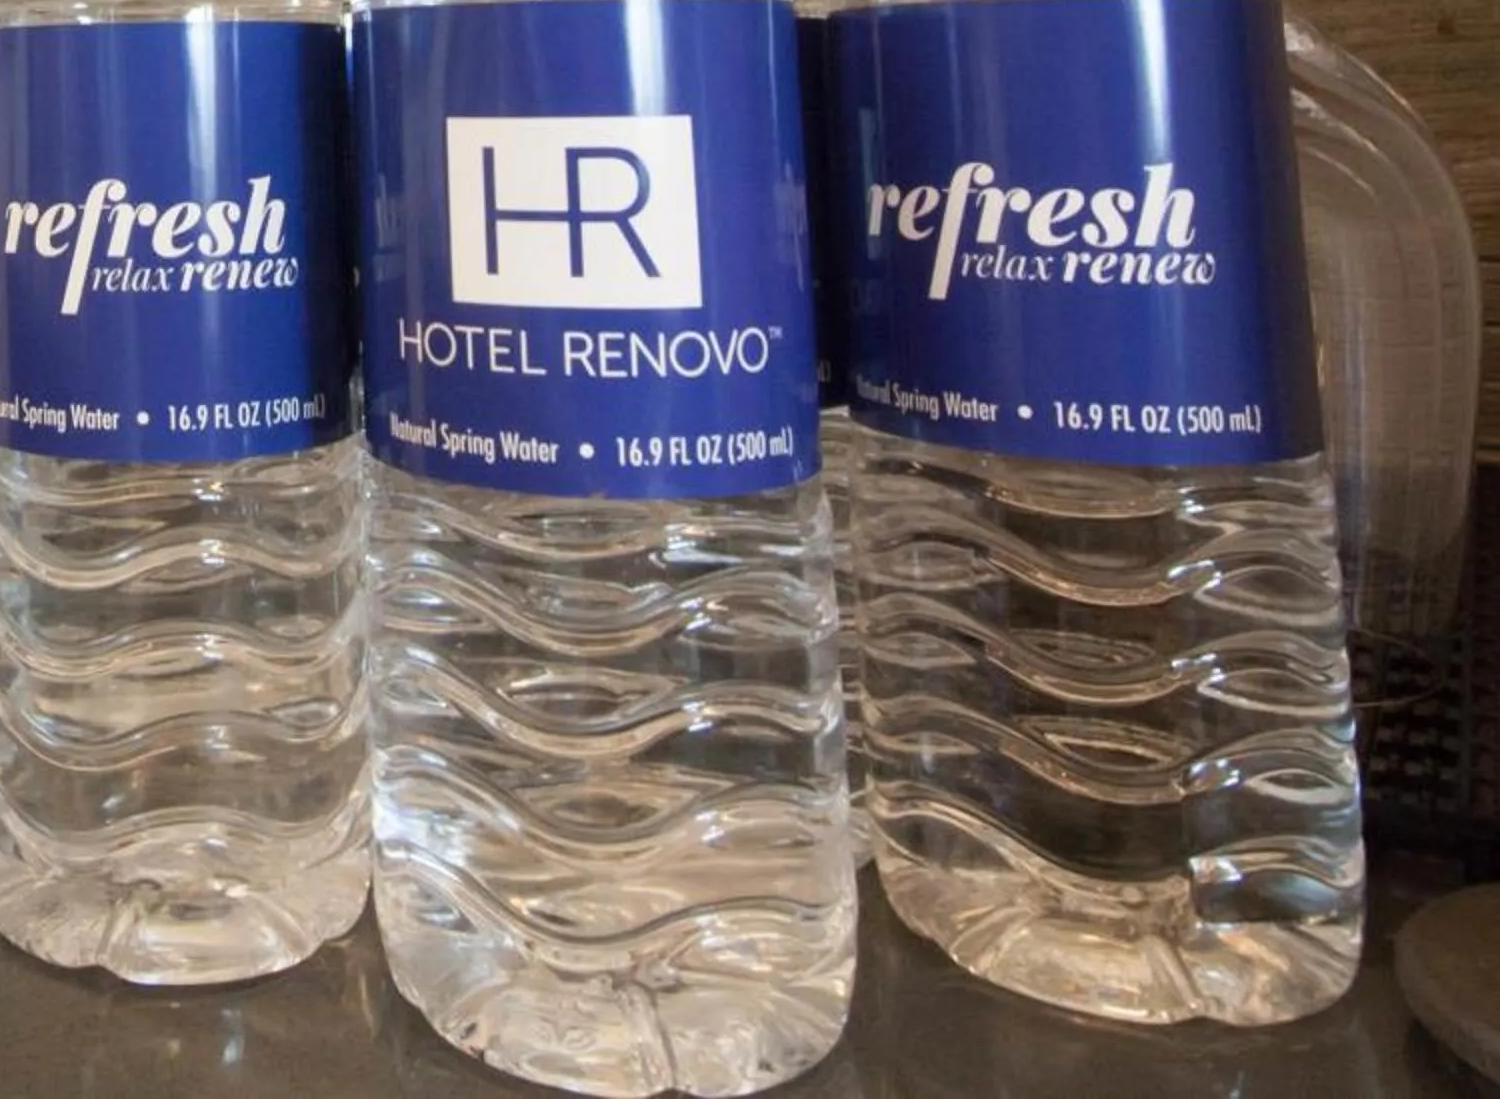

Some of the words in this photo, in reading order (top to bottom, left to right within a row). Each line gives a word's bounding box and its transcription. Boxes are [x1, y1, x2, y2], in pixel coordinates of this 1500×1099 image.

[482, 146, 662, 278] HR
[867, 161, 1195, 301] refresh
[4, 174, 285, 315] refresh
[92, 253, 175, 292] relax
[180, 255, 299, 293] renew
[960, 245, 1054, 282] relax
[1062, 251, 1216, 286] renew
[397, 318, 547, 377] HOTEL
[21, 397, 67, 433] Spring
[70, 403, 121, 431] Water
[167, 403, 209, 432] 16.9
[213, 403, 234, 430] FL
[237, 401, 262, 428] OZ
[265, 395, 300, 429] (500
[891, 382, 939, 421] Spring
[943, 390, 999, 422] Water
[1053, 400, 1103, 431] 16.9
[1111, 403, 1136, 433] FL
[1140, 404, 1172, 433] OZ
[1177, 405, 1225, 436] (500
[389, 410, 437, 448] Natural
[440, 422, 496, 464] Spring
[499, 430, 560, 464] Water
[615, 436, 664, 468] 16.9
[668, 436, 693, 467] FL
[696, 434, 724, 465] OZ
[727, 430, 767, 466] (500
